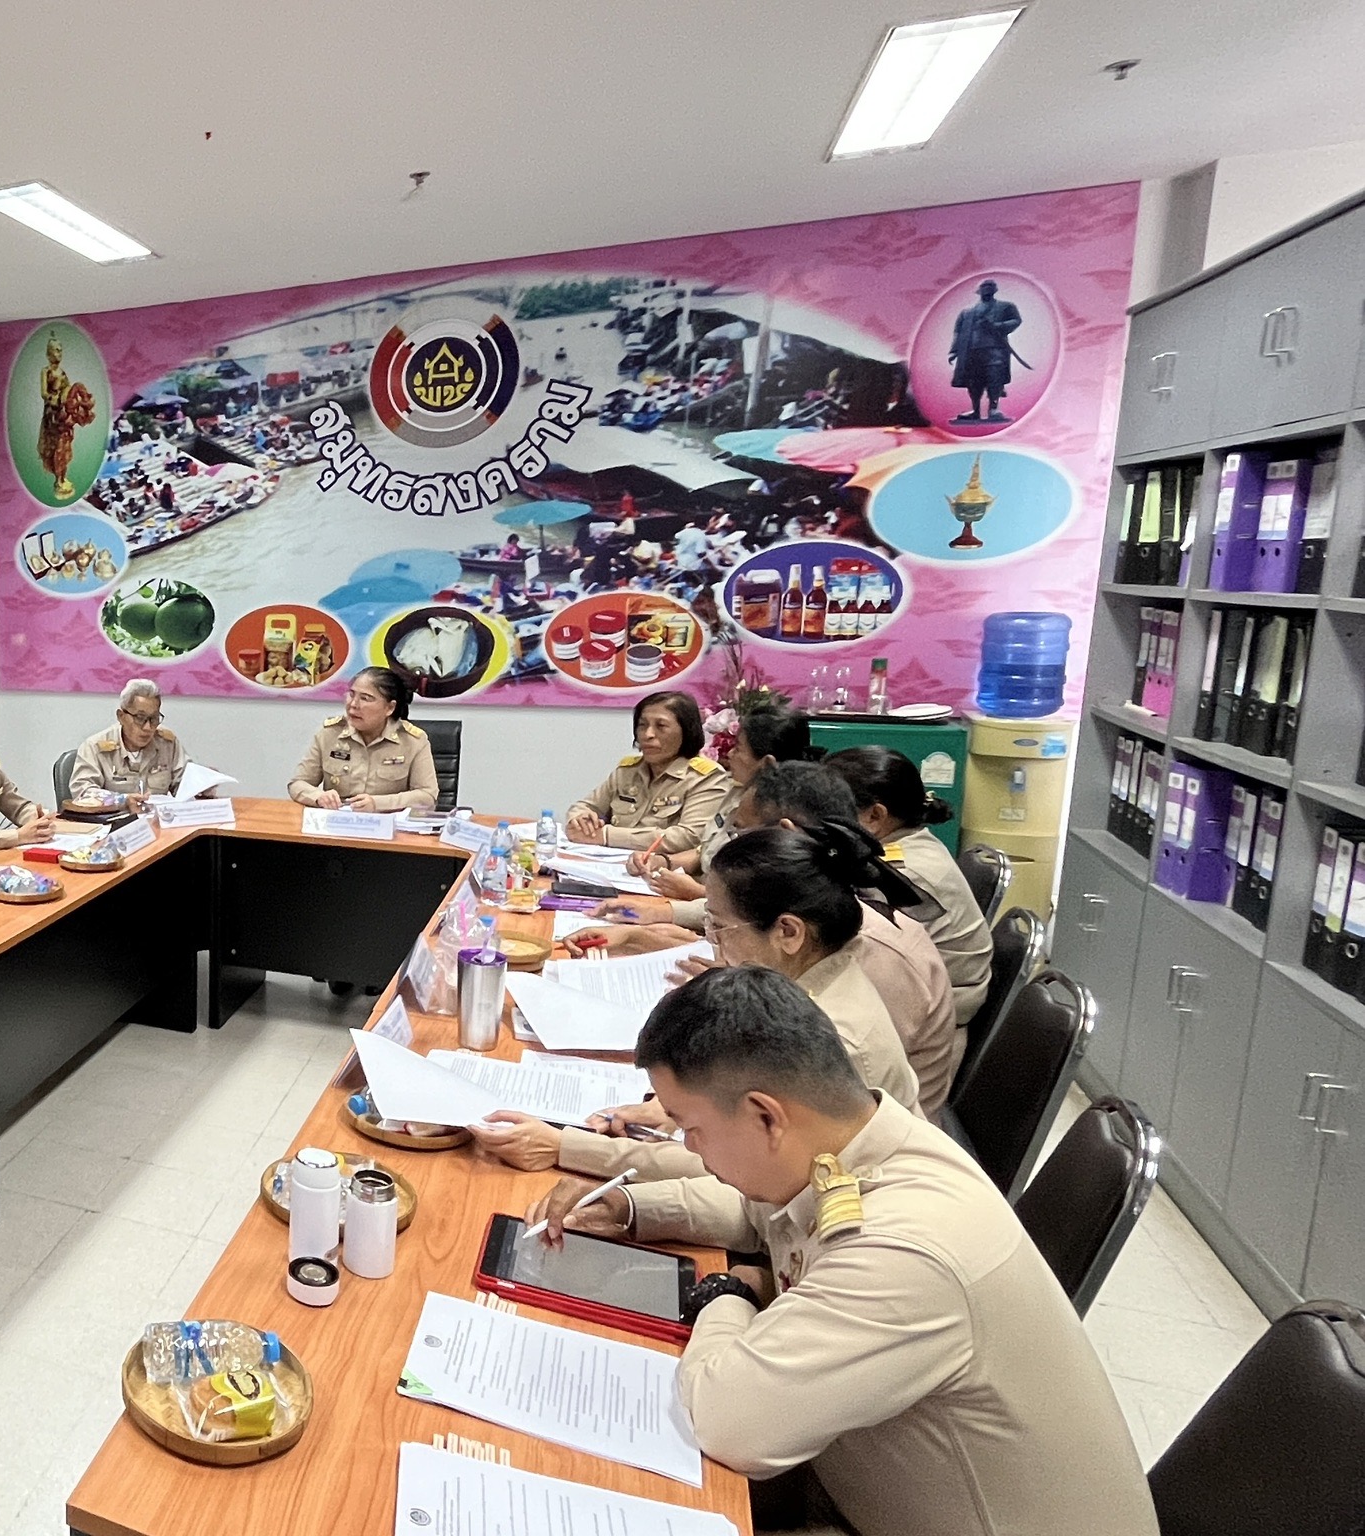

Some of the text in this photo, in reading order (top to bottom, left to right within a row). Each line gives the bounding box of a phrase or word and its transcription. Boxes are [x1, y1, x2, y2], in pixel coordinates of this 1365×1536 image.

[309, 379, 593, 516] สมุทรสงคราม
